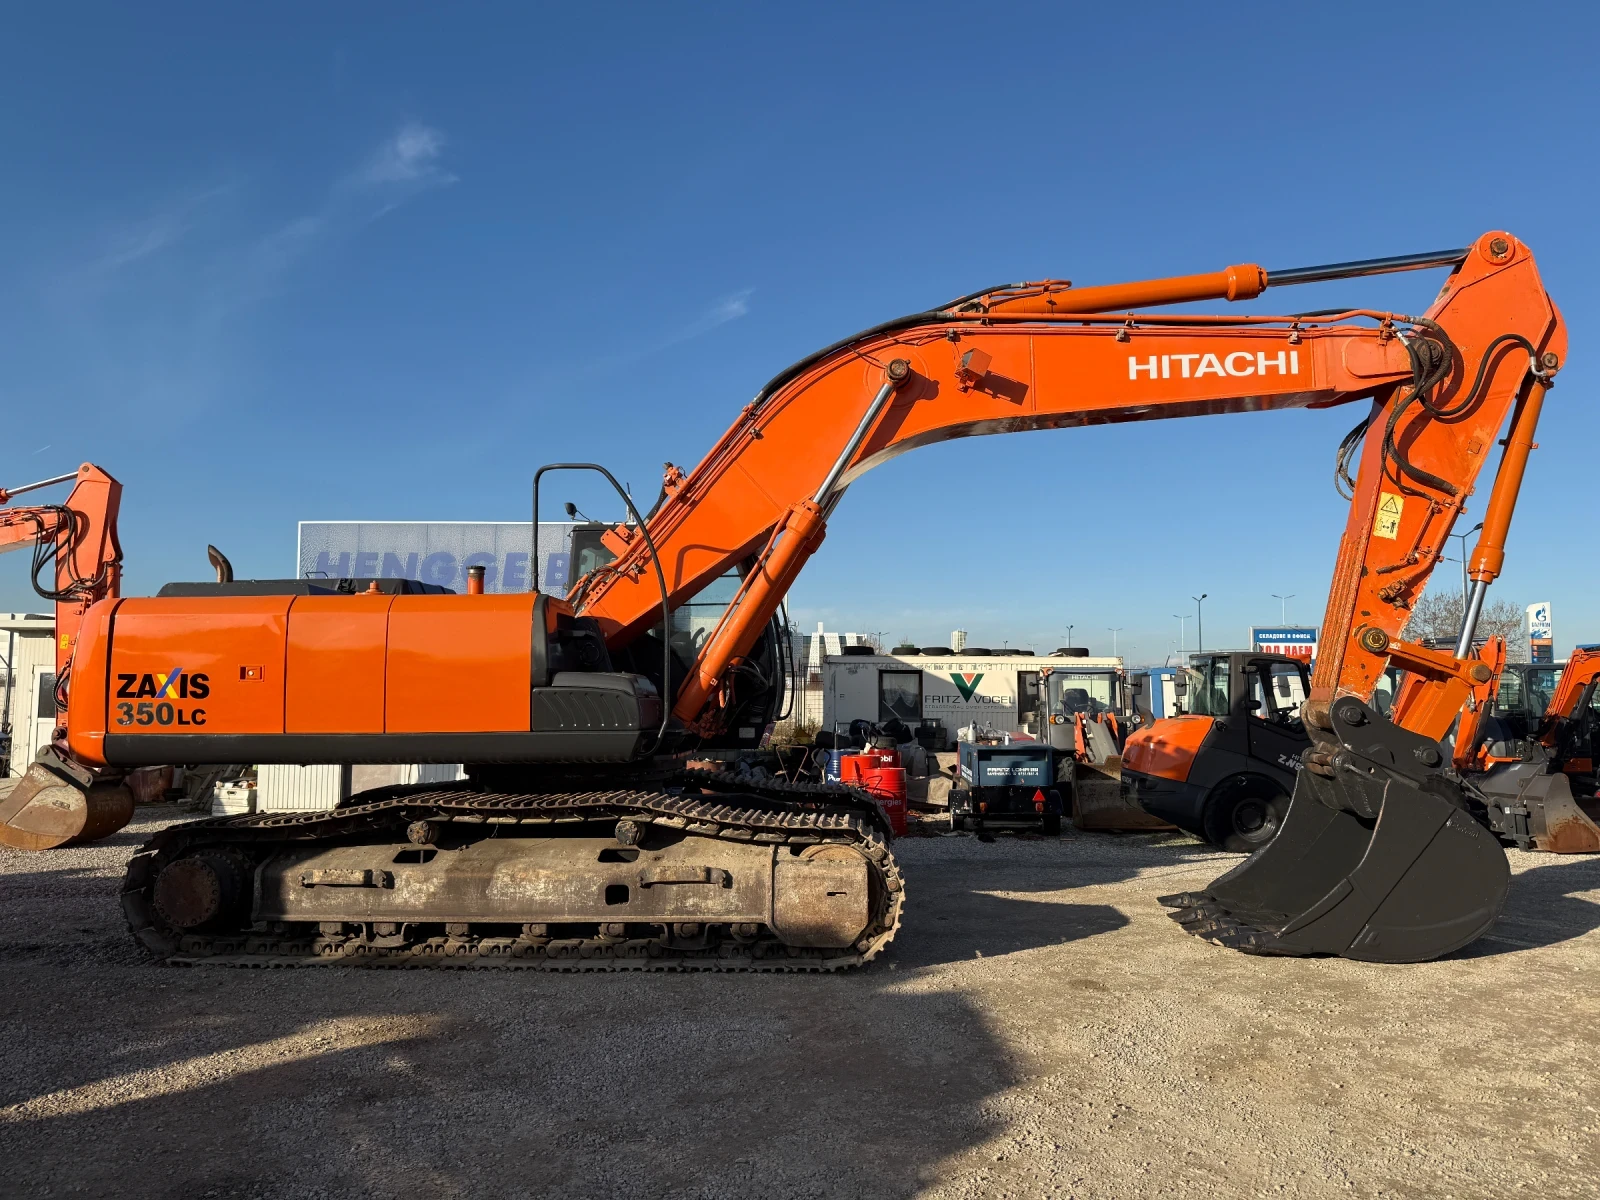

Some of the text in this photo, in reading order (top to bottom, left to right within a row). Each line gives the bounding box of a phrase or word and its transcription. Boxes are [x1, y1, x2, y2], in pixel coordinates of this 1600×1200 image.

[1128, 350, 1299, 381] HITACHI
[316, 551, 533, 587] HENGGE
[1284, 645, 1313, 656] НАЕМ
[116, 667, 210, 699] ZAXIS
[924, 695, 1016, 704] FRITZ VOGEL
[879, 799, 902, 808] ergies
